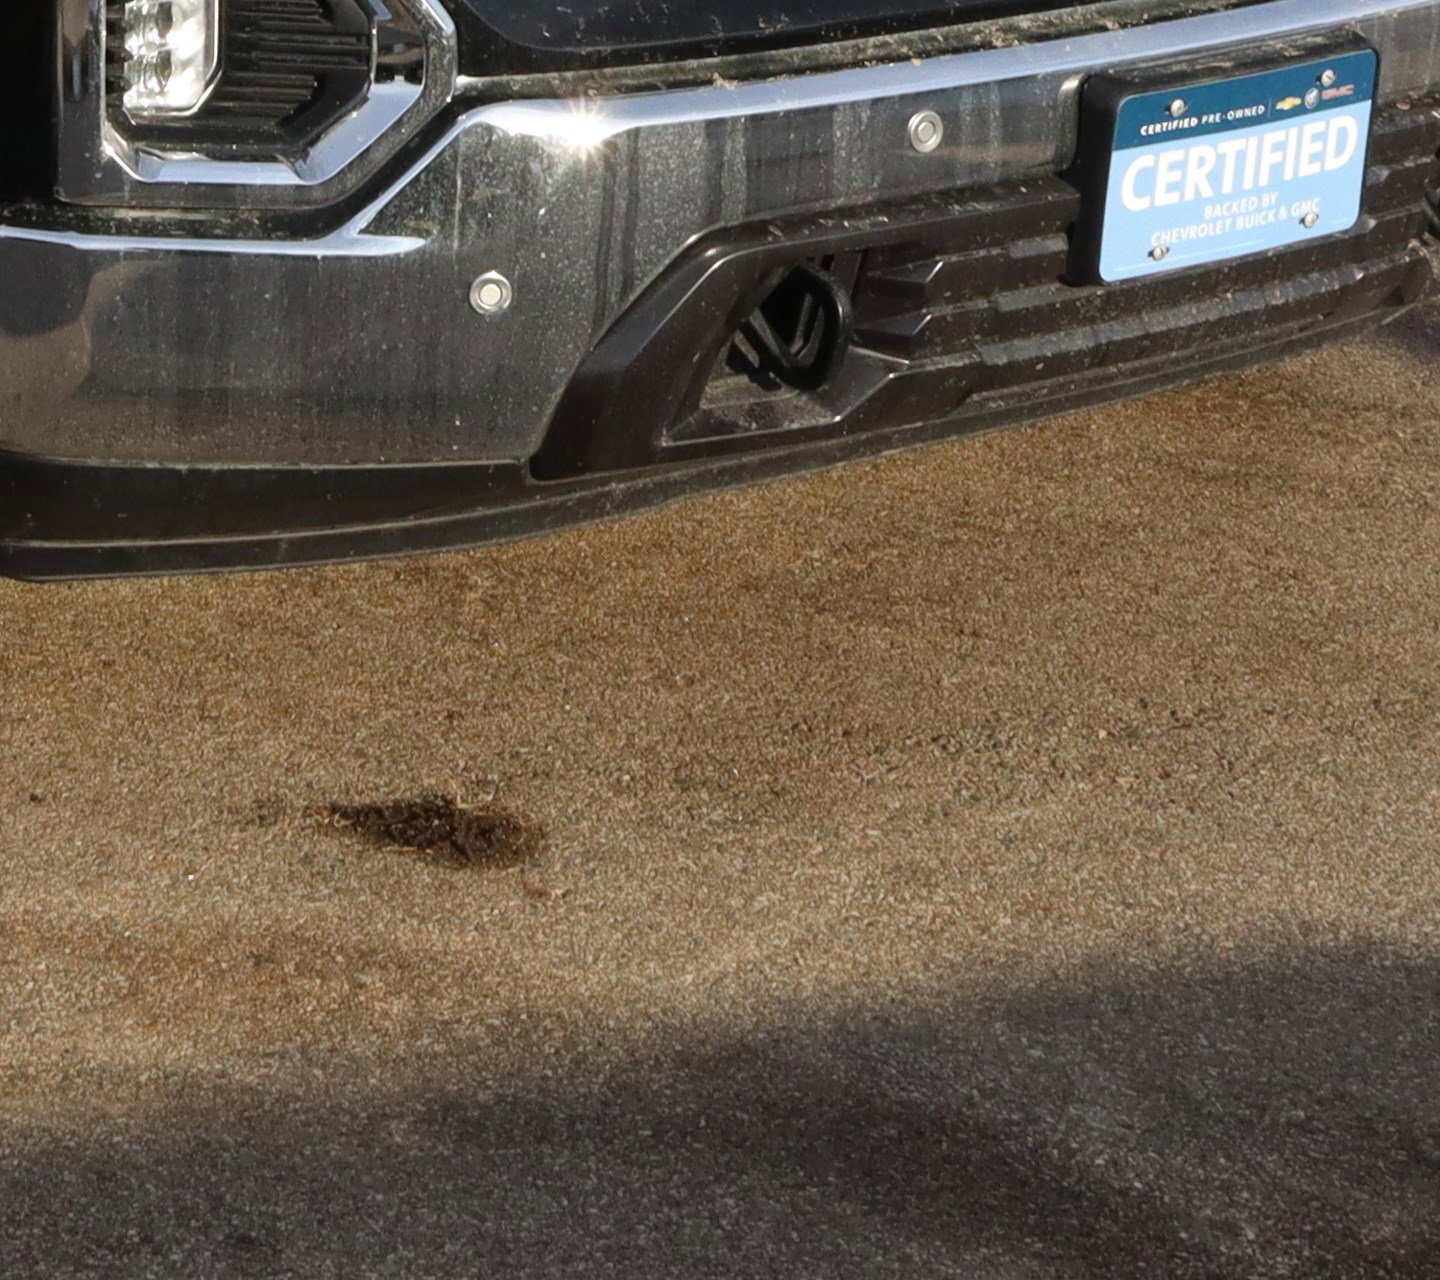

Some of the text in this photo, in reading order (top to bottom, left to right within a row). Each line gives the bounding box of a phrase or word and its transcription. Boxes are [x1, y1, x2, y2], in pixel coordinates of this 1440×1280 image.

[1139, 117, 1199, 137] CERTIFIED
[1120, 114, 1359, 213] CERTIFIED
[1151, 196, 1321, 247] CHEVROLET BUICK & GMC
[1204, 191, 1279, 220] BACKED BY
